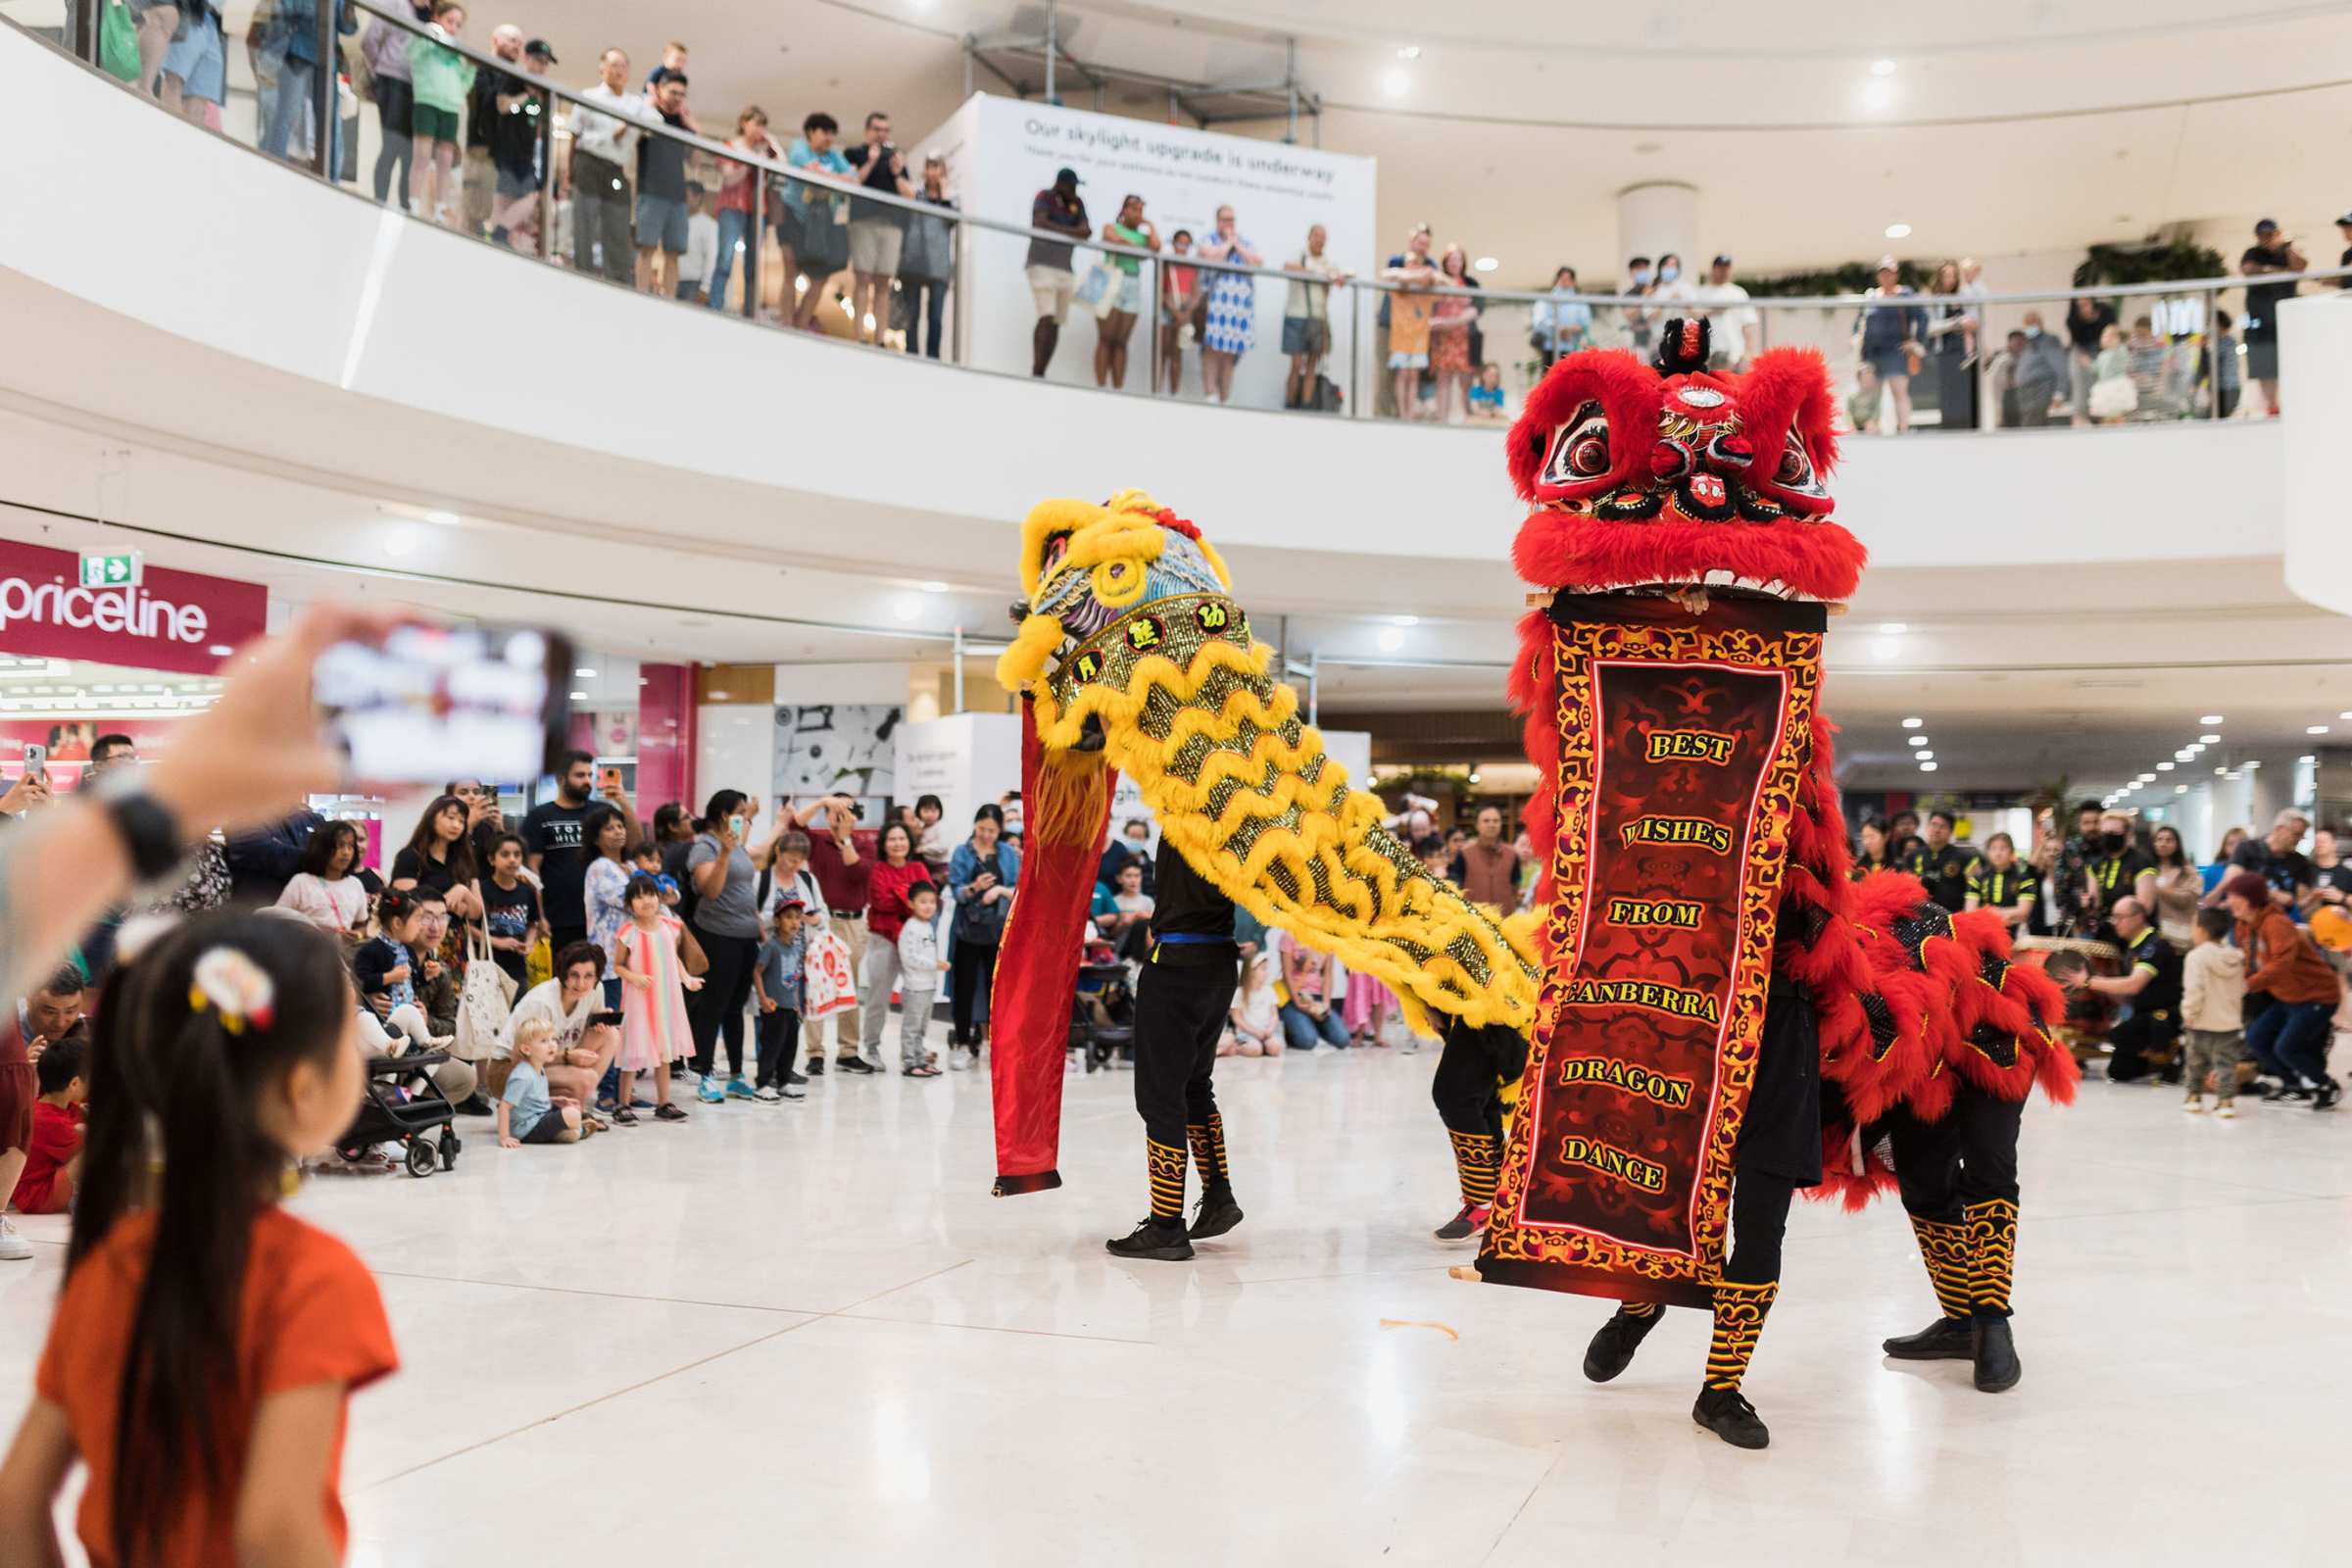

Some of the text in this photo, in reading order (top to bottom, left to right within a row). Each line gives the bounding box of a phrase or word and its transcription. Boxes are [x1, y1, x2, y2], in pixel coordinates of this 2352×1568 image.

[1025, 119, 1059, 136] Our
[1067, 125, 1140, 149] skylight
[1146, 142, 1221, 164] upgrade
[1230, 153, 1242, 168] is
[1248, 158, 1335, 183] underway
[0, 574, 209, 644] priceline
[1649, 732, 1733, 763] BEST
[1623, 817, 1732, 853] WISHES
[1608, 902, 1700, 927] FROM
[1563, 981, 1720, 1023] CANBERRA
[1564, 1059, 1690, 1105] DRAGON
[1566, 1139, 1663, 1191] DANCE
